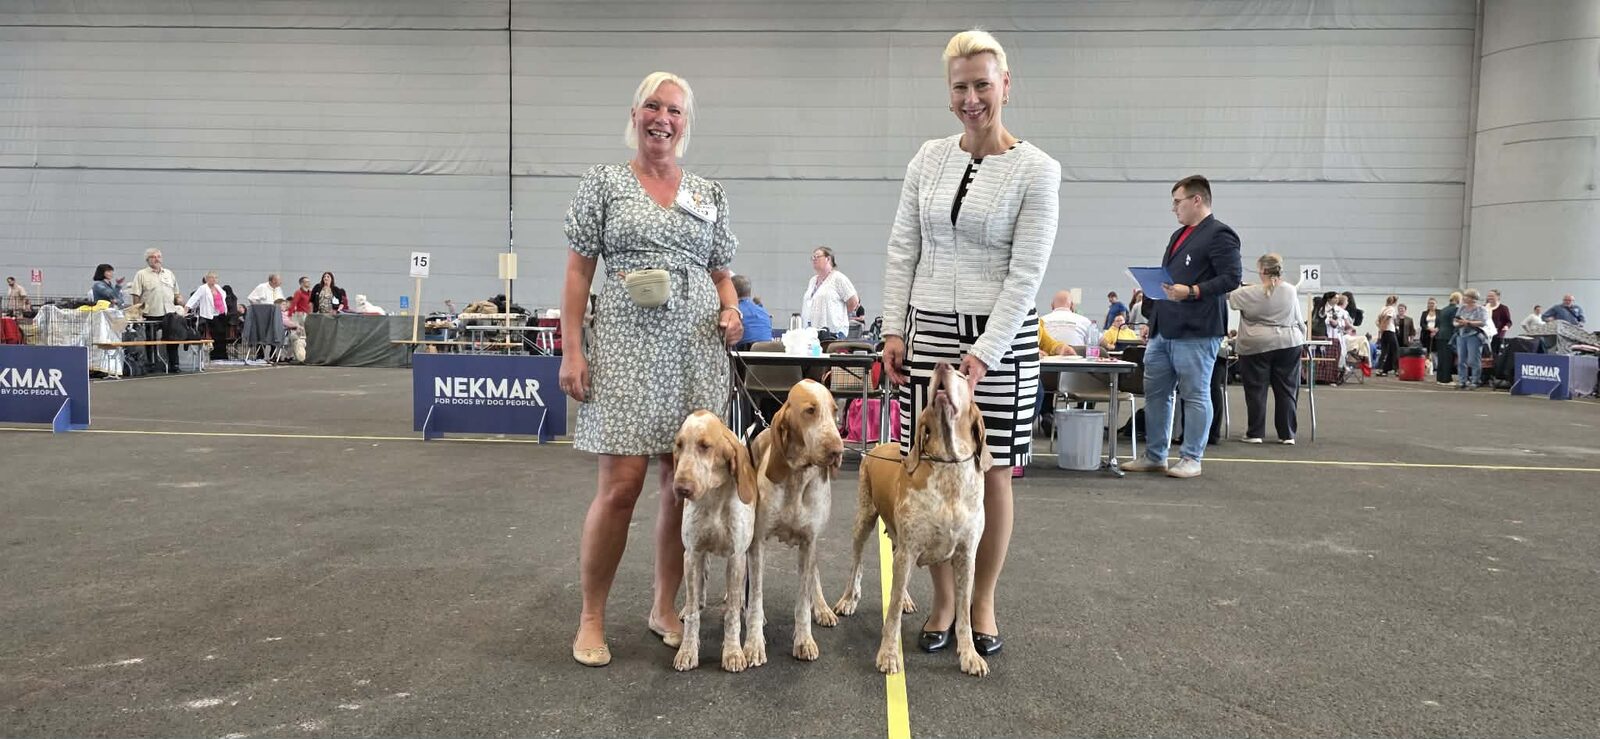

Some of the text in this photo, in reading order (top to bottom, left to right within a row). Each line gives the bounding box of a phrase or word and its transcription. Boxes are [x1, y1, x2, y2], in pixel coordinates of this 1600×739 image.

[413, 256, 427, 267] 15
[1303, 269, 1318, 280] 16
[1521, 364, 1561, 382] NEKMAR
[435, 377, 545, 406] NEKMAR
